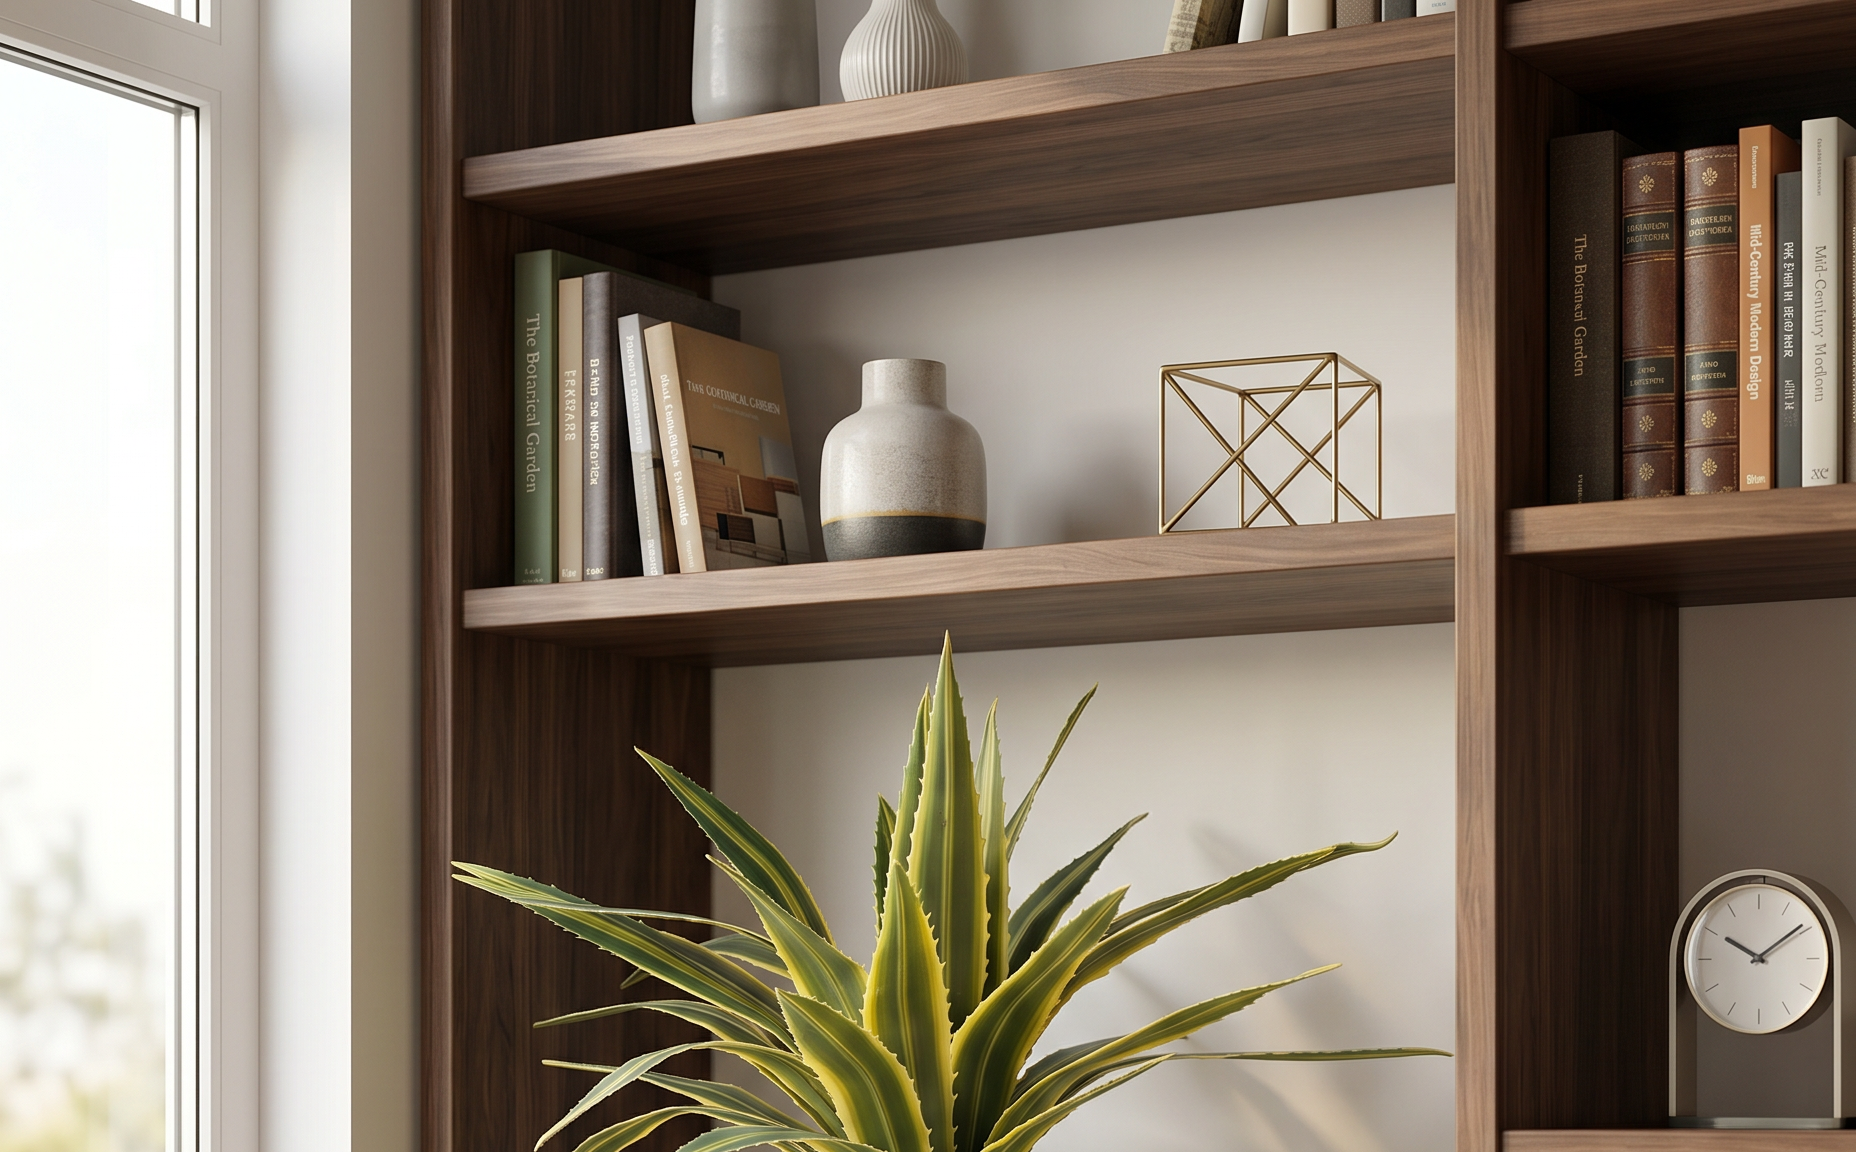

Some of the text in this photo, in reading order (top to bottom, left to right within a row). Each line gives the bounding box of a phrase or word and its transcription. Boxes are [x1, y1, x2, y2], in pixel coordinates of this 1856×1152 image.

[1574, 233, 1588, 261] The
[526, 312, 541, 347] The
[526, 432, 541, 493] Garden
